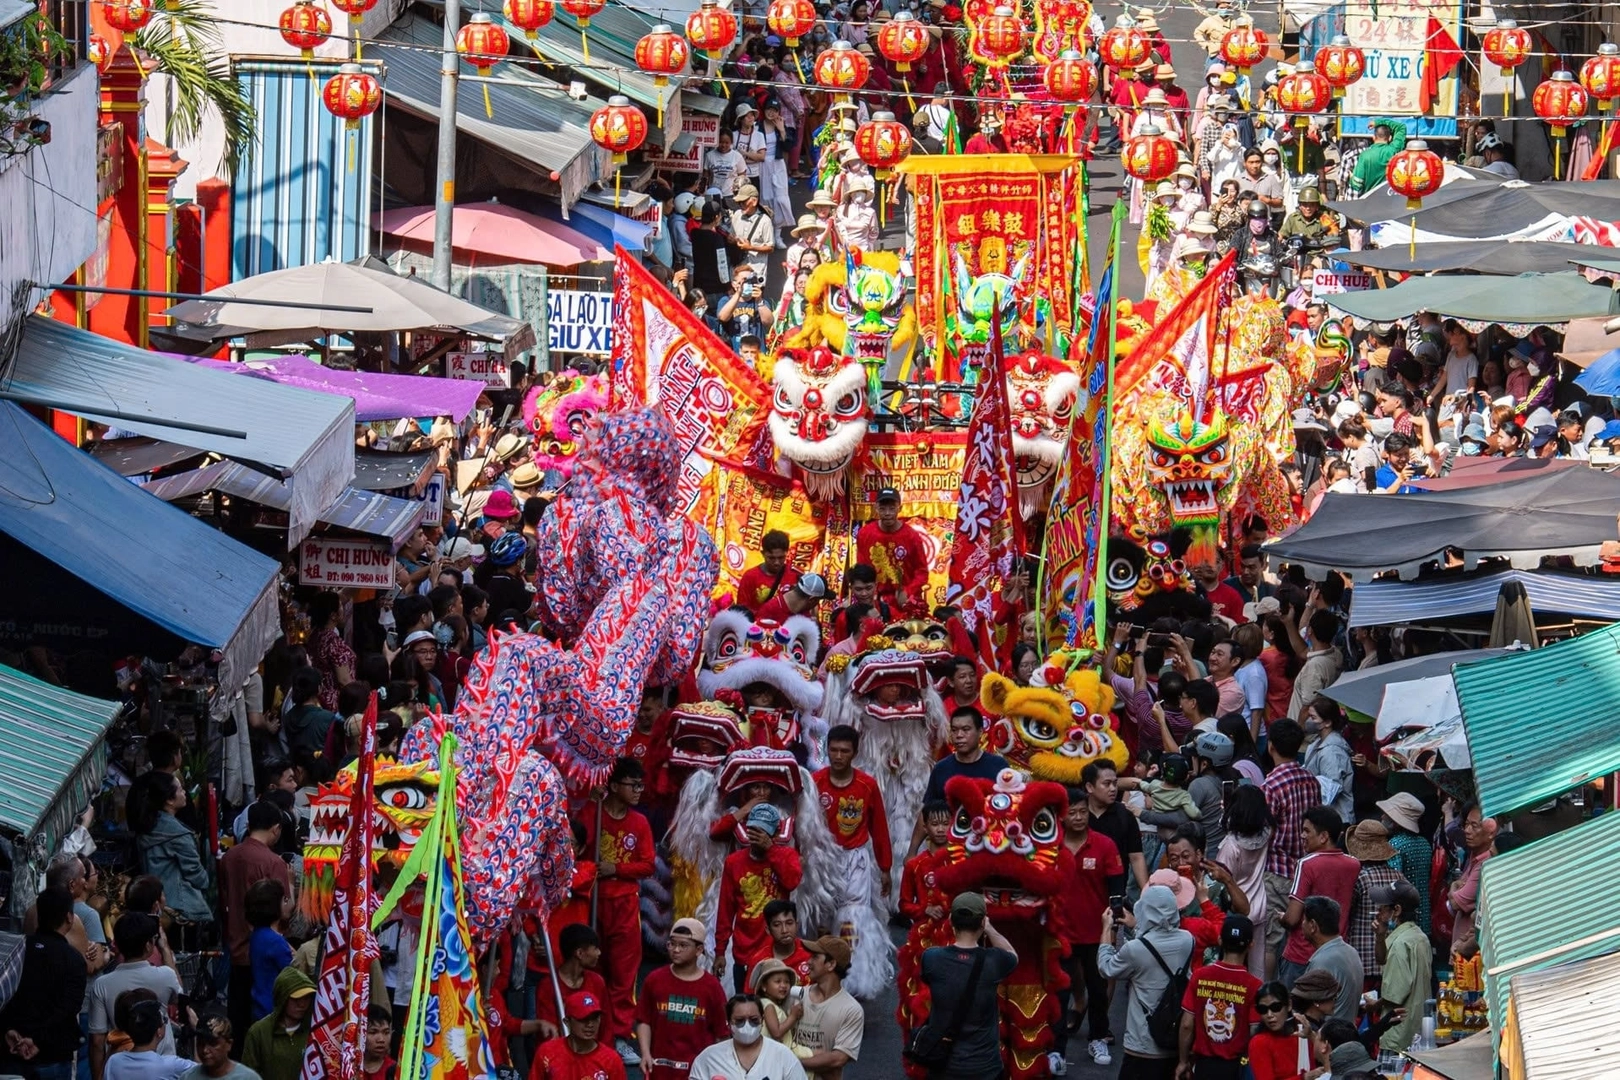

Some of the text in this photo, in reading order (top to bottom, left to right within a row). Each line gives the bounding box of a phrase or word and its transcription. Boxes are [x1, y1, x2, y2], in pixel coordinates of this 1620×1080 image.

[1387, 57, 1411, 79] XE
[1316, 275, 1339, 289] CHỊ
[567, 293, 597, 324] LÃO
[922, 453, 949, 469] NAM
[327, 548, 350, 569] CHỊ
[342, 573, 354, 582] 090
[357, 573, 373, 583] 7960
[375, 574, 388, 584] 818
